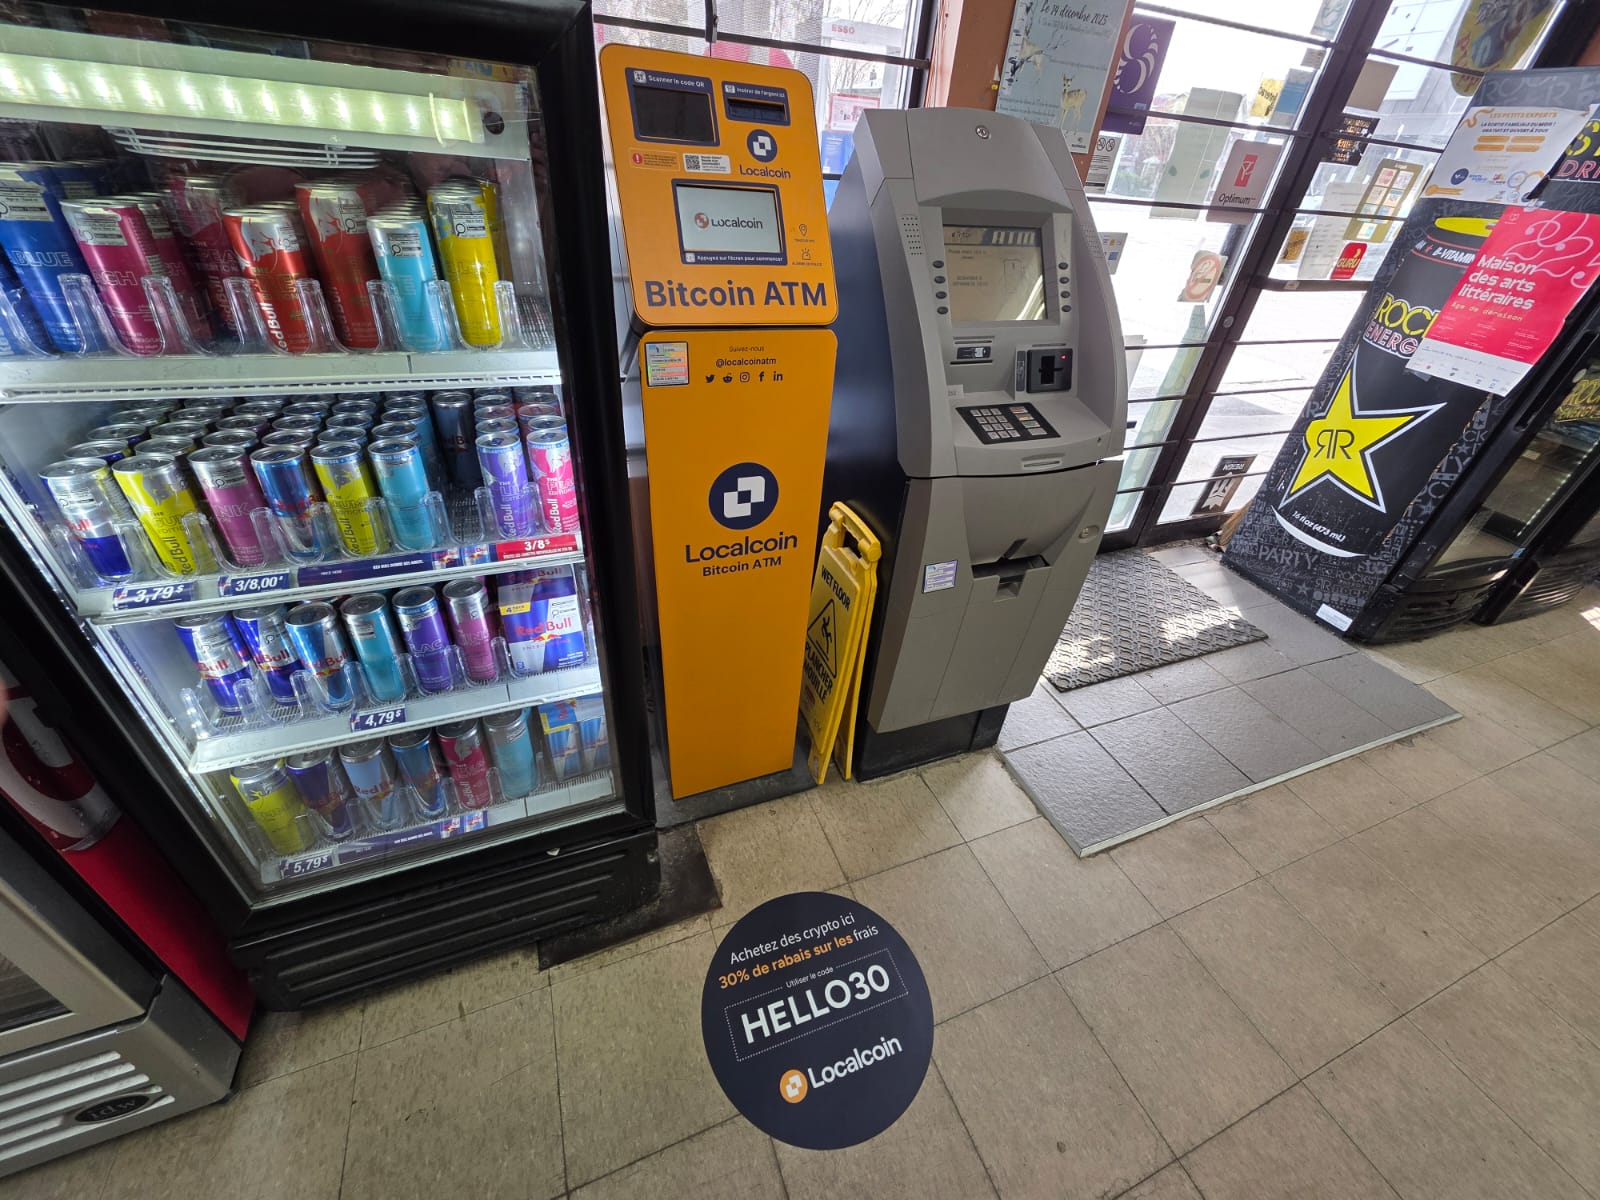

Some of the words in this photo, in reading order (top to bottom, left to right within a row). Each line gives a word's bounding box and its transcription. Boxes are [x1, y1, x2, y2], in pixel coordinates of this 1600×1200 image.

[831, 23, 855, 35] ESSO
[739, 164, 791, 179] Localcoin
[711, 216, 763, 229] Localcoin
[14, 250, 74, 267] BLUE
[1336, 257, 1361, 269] GURU
[1477, 254, 1538, 275] Maison
[1468, 269, 1498, 287] des
[1499, 275, 1537, 293] arts
[645, 279, 755, 307] Bitcoin
[763, 281, 828, 307] ATM
[1458, 283, 1536, 311] littéraires
[1365, 321, 1417, 354] ENERG
[729, 345, 765, 353] Suivez-nous
[715, 356, 777, 368] @localcoinatm
[547, 498, 560, 517] Bull
[1292, 510, 1300, 520] 16
[1312, 521, 1331, 536] (473
[161, 536, 185, 556] Bull
[685, 531, 798, 563] Localcoin
[702, 561, 750, 577] Bitcoin
[752, 555, 782, 570] ATM
[1258, 545, 1319, 570] PARTY
[821, 565, 833, 588] WET
[832, 580, 851, 611] FLOOR
[515, 622, 545, 637] Red
[545, 616, 572, 632] Bull
[263, 648, 290, 663] Bull
[805, 643, 833, 695] PLANCHER
[365, 709, 402, 727] 4,79$
[293, 855, 329, 874] 5,79$
[730, 940, 779, 965] Achetez
[780, 932, 802, 948] des
[803, 918, 841, 941] crypto
[841, 912, 855, 926] ici
[719, 968, 750, 990] 30%
[752, 962, 770, 979] de
[772, 948, 812, 972] rabais
[813, 941, 833, 957] sur
[834, 933, 854, 950] les
[852, 924, 879, 943] frais
[786, 971, 809, 989] Utiliser
[809, 969, 817, 980] le
[817, 966, 834, 978] code
[741, 964, 890, 1044] HELLO30
[808, 1036, 903, 1089] Localcoin
